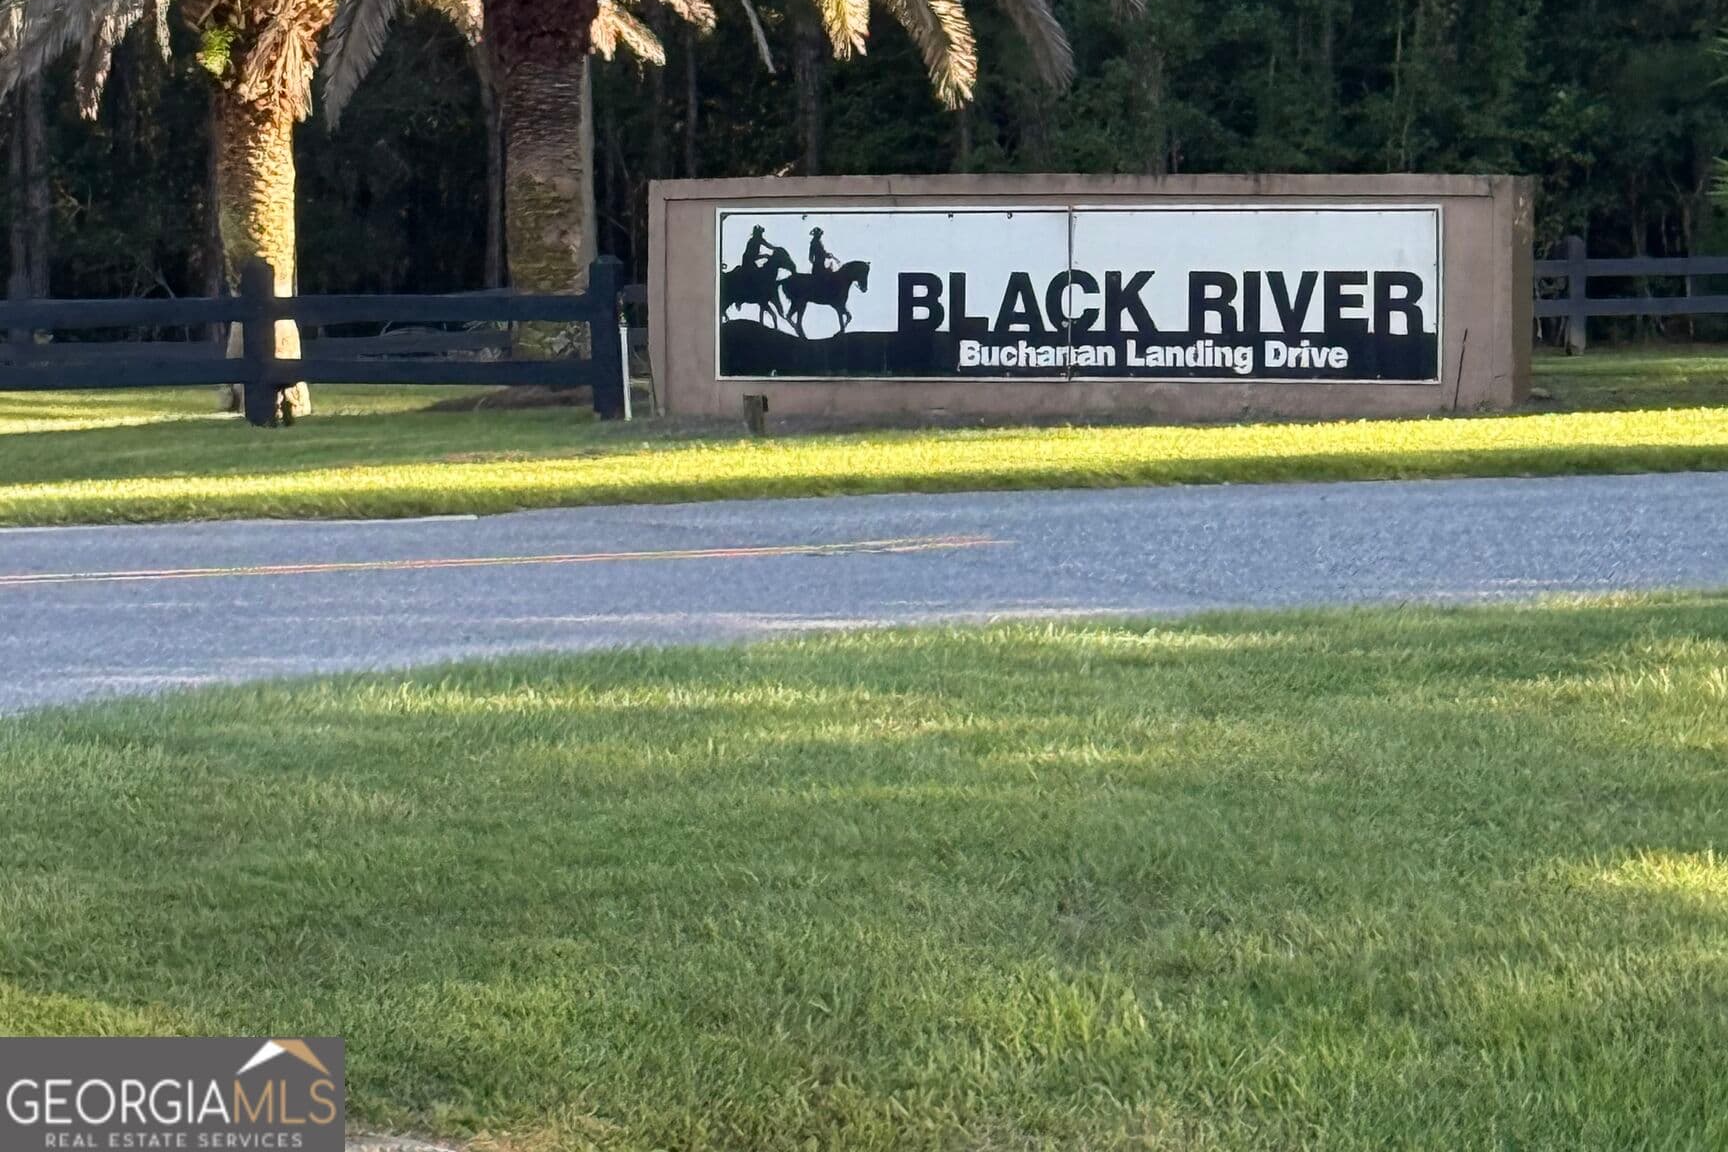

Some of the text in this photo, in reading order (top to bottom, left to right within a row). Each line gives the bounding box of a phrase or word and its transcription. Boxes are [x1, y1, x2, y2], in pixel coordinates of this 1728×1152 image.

[897, 270, 1425, 335] BLACK RIVER
[959, 339, 1349, 374] Buchanan Landing Drive
